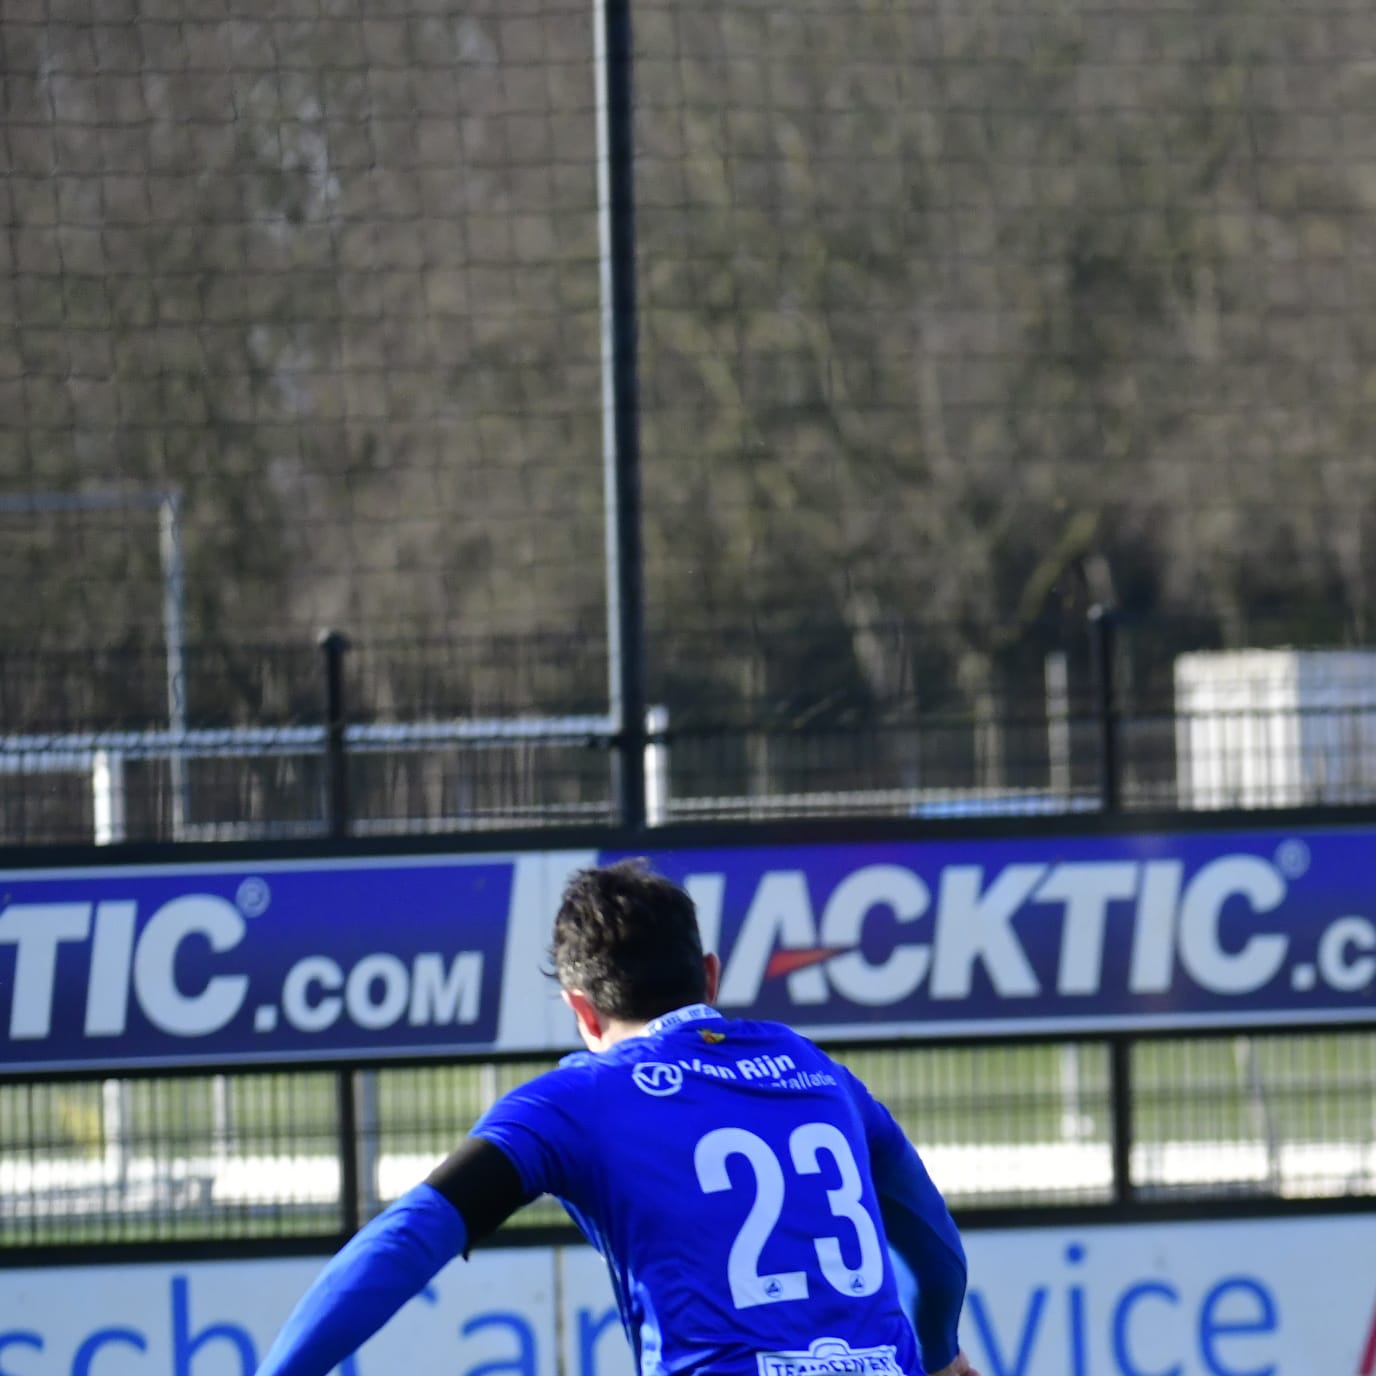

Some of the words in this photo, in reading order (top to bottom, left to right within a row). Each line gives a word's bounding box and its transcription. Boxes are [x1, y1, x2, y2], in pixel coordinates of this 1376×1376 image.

[0, 893, 484, 1040] TIC.COM
[735, 1054, 796, 1081] Rijn
[694, 1122, 884, 1310] 23
